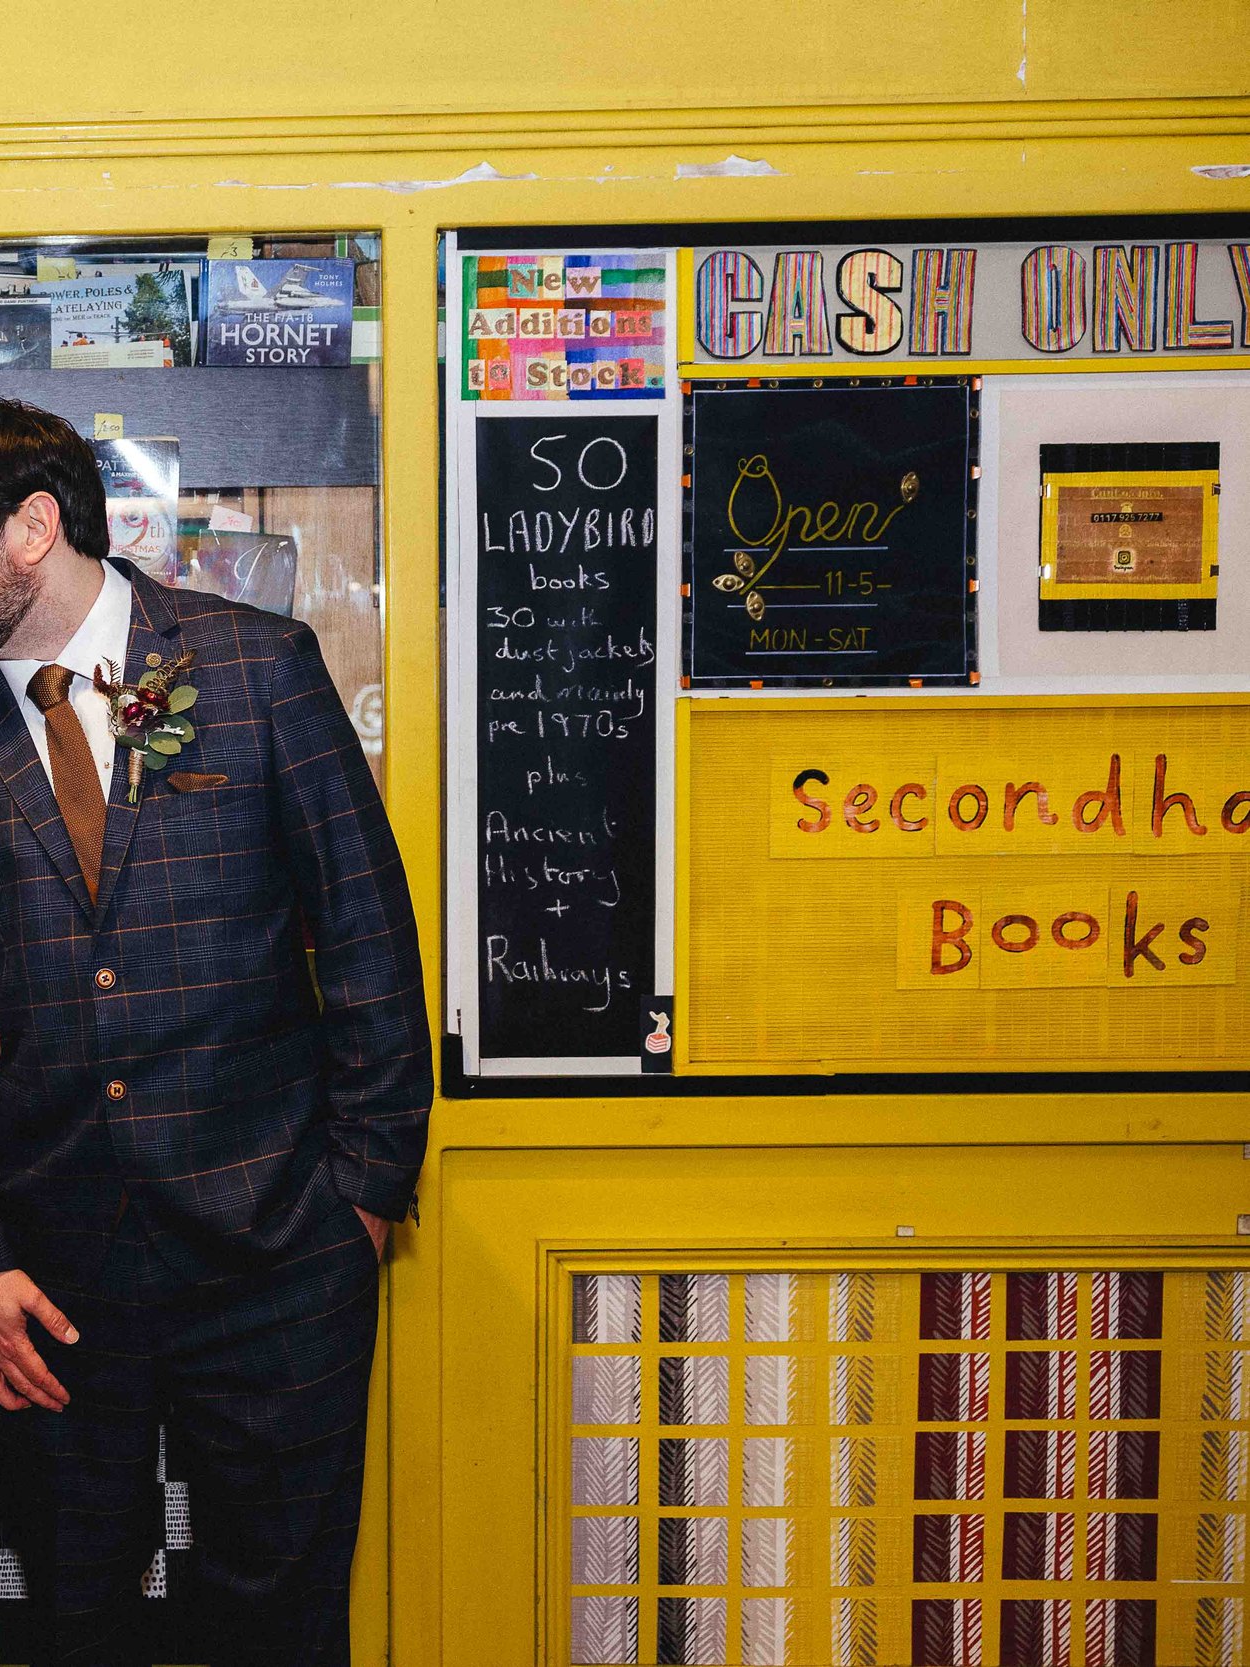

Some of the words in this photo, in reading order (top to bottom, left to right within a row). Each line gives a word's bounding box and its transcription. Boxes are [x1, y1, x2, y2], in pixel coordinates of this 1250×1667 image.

[85, 287, 123, 298] POLES
[124, 284, 134, 295] &
[509, 268, 600, 295] New
[51, 301, 122, 314] ATELAYING
[697, 248, 978, 360] CASH
[246, 313, 270, 323] THE
[468, 311, 652, 336] Additions
[221, 323, 338, 346] HORNET
[245, 348, 311, 363] STORY
[468, 360, 509, 387] to
[530, 434, 628, 492] 50
[483, 506, 656, 554] LADYBIRD
[728, 454, 905, 596] Open
[110, 545, 160, 554] HRISTMAS
[528, 564, 611, 591] books
[487, 606, 536, 628] 30
[547, 607, 603, 627] with
[495, 637, 559, 662] dust
[490, 674, 550, 702] and
[488, 720, 526, 743] pre
[538, 710, 630, 739] 1970s
[527, 755, 588, 795] plus
[485, 806, 617, 845] Ancient
[485, 854, 621, 907] History
[930, 890, 1210, 978] Books
